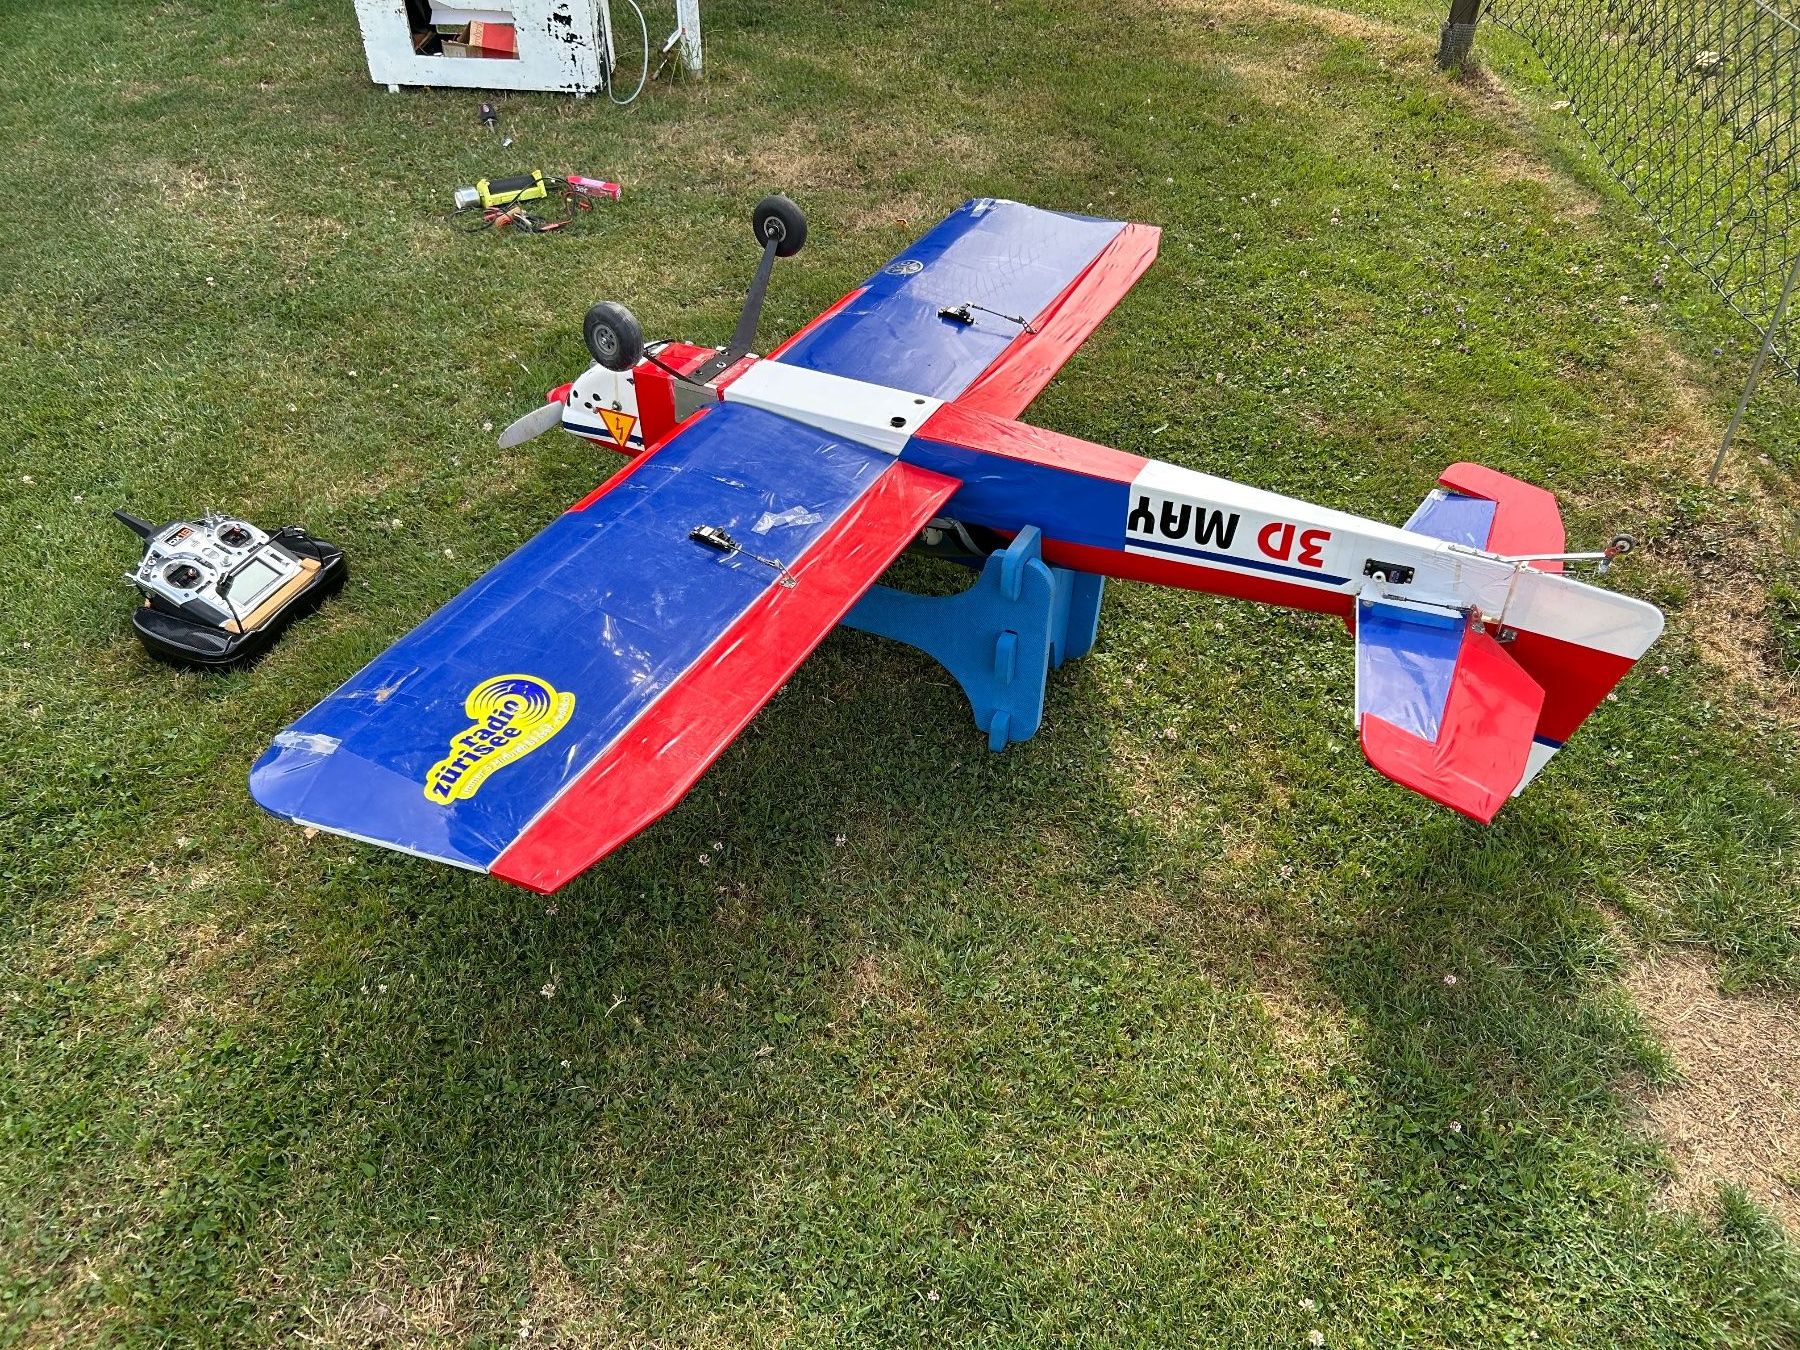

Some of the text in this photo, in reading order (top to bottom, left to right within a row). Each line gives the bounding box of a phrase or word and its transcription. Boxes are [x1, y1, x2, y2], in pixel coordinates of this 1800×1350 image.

[1127, 495, 1332, 569] 3D MAY
[458, 699, 520, 748] radio
[432, 727, 522, 798] zürisee
